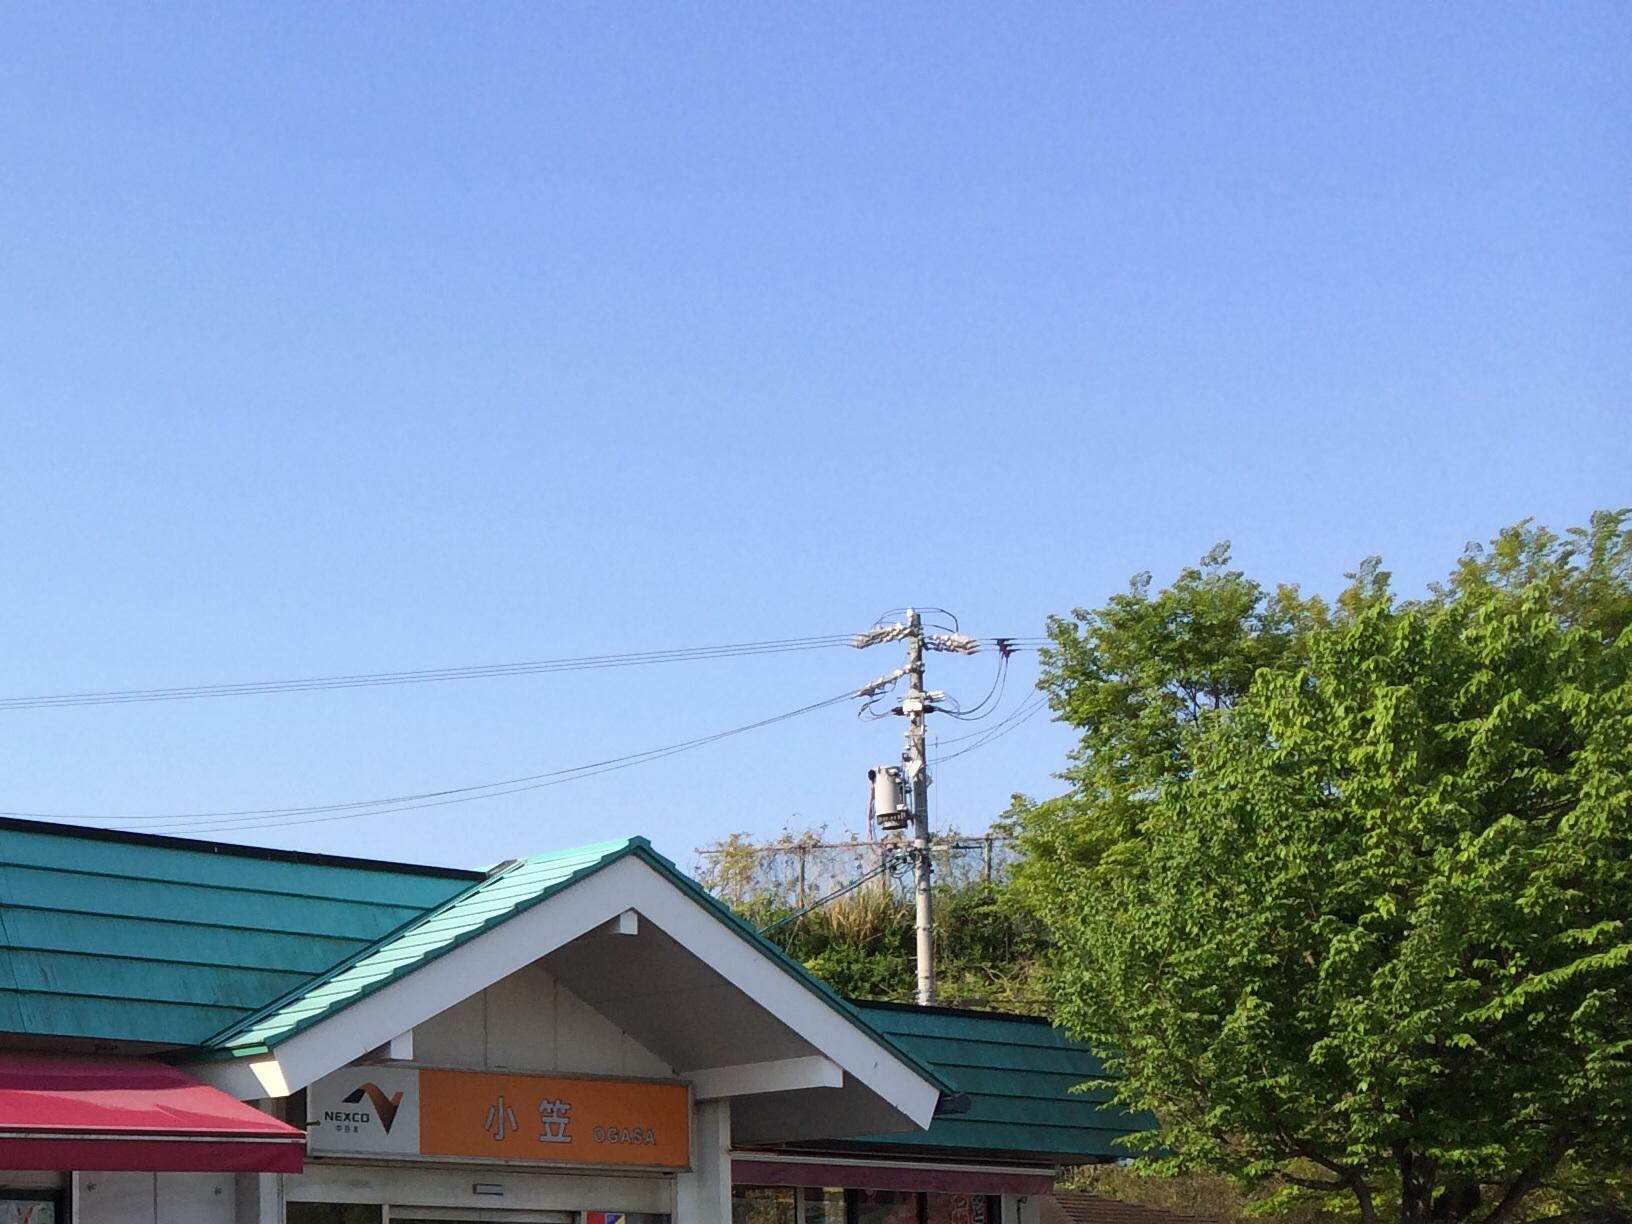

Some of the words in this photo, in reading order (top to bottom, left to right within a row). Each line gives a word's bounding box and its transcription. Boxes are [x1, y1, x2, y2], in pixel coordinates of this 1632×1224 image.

[324, 1111, 370, 1123] NEXCO
[483, 1095, 573, 1144] 小笠
[592, 1125, 658, 1147] OGASA
